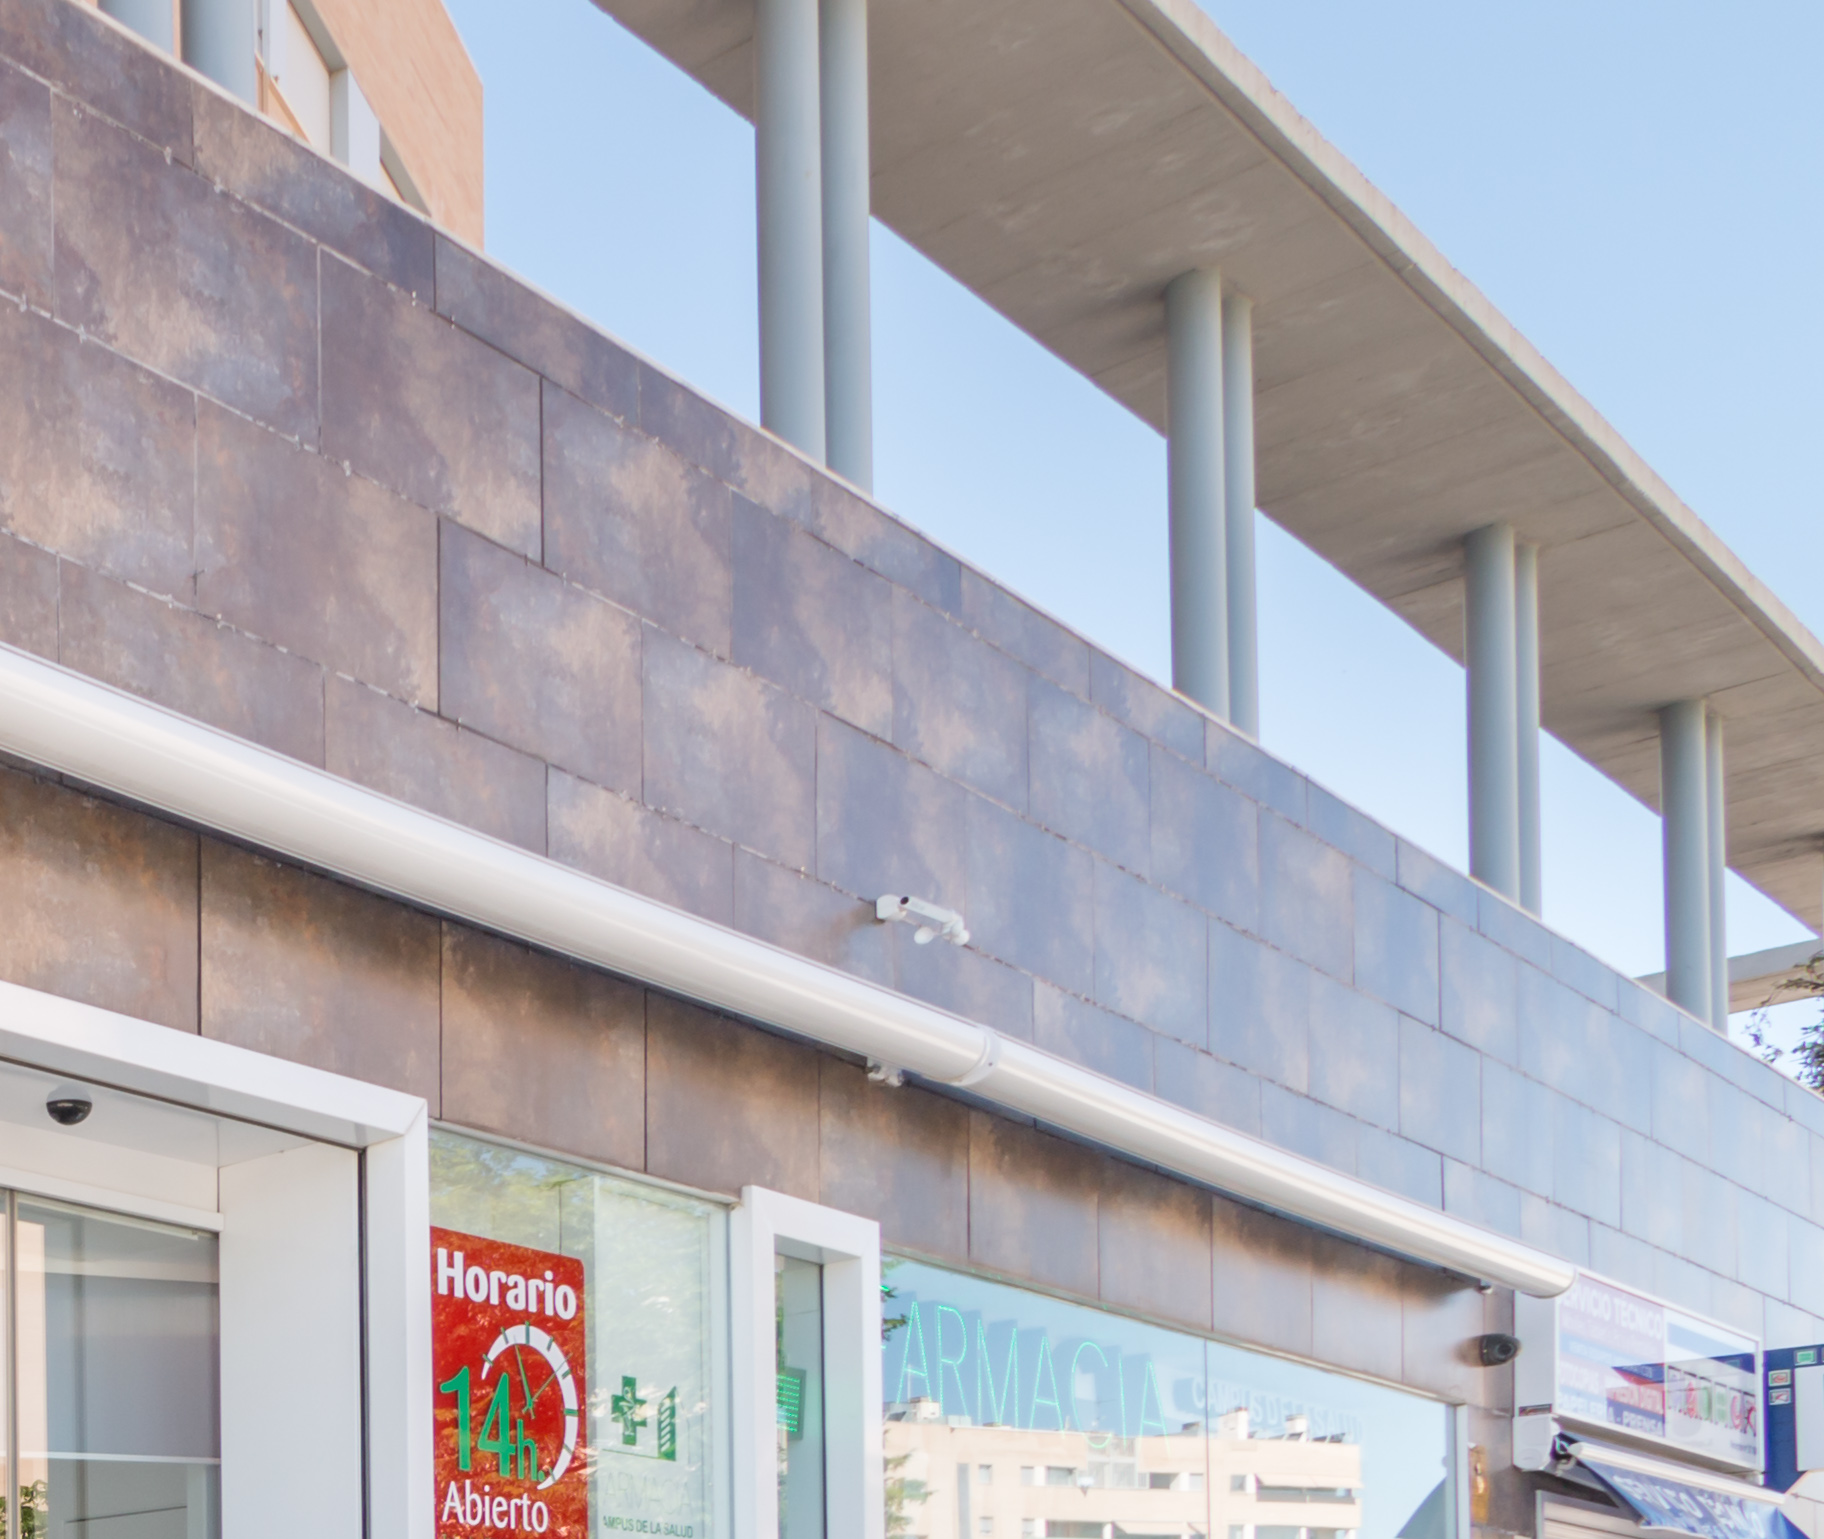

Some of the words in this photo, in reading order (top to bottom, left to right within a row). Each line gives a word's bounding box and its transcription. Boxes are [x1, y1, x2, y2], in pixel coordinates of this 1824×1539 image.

[437, 1247, 578, 1320] Horario
[439, 1366, 547, 1483] 14h.
[441, 1481, 550, 1533] Abierto
